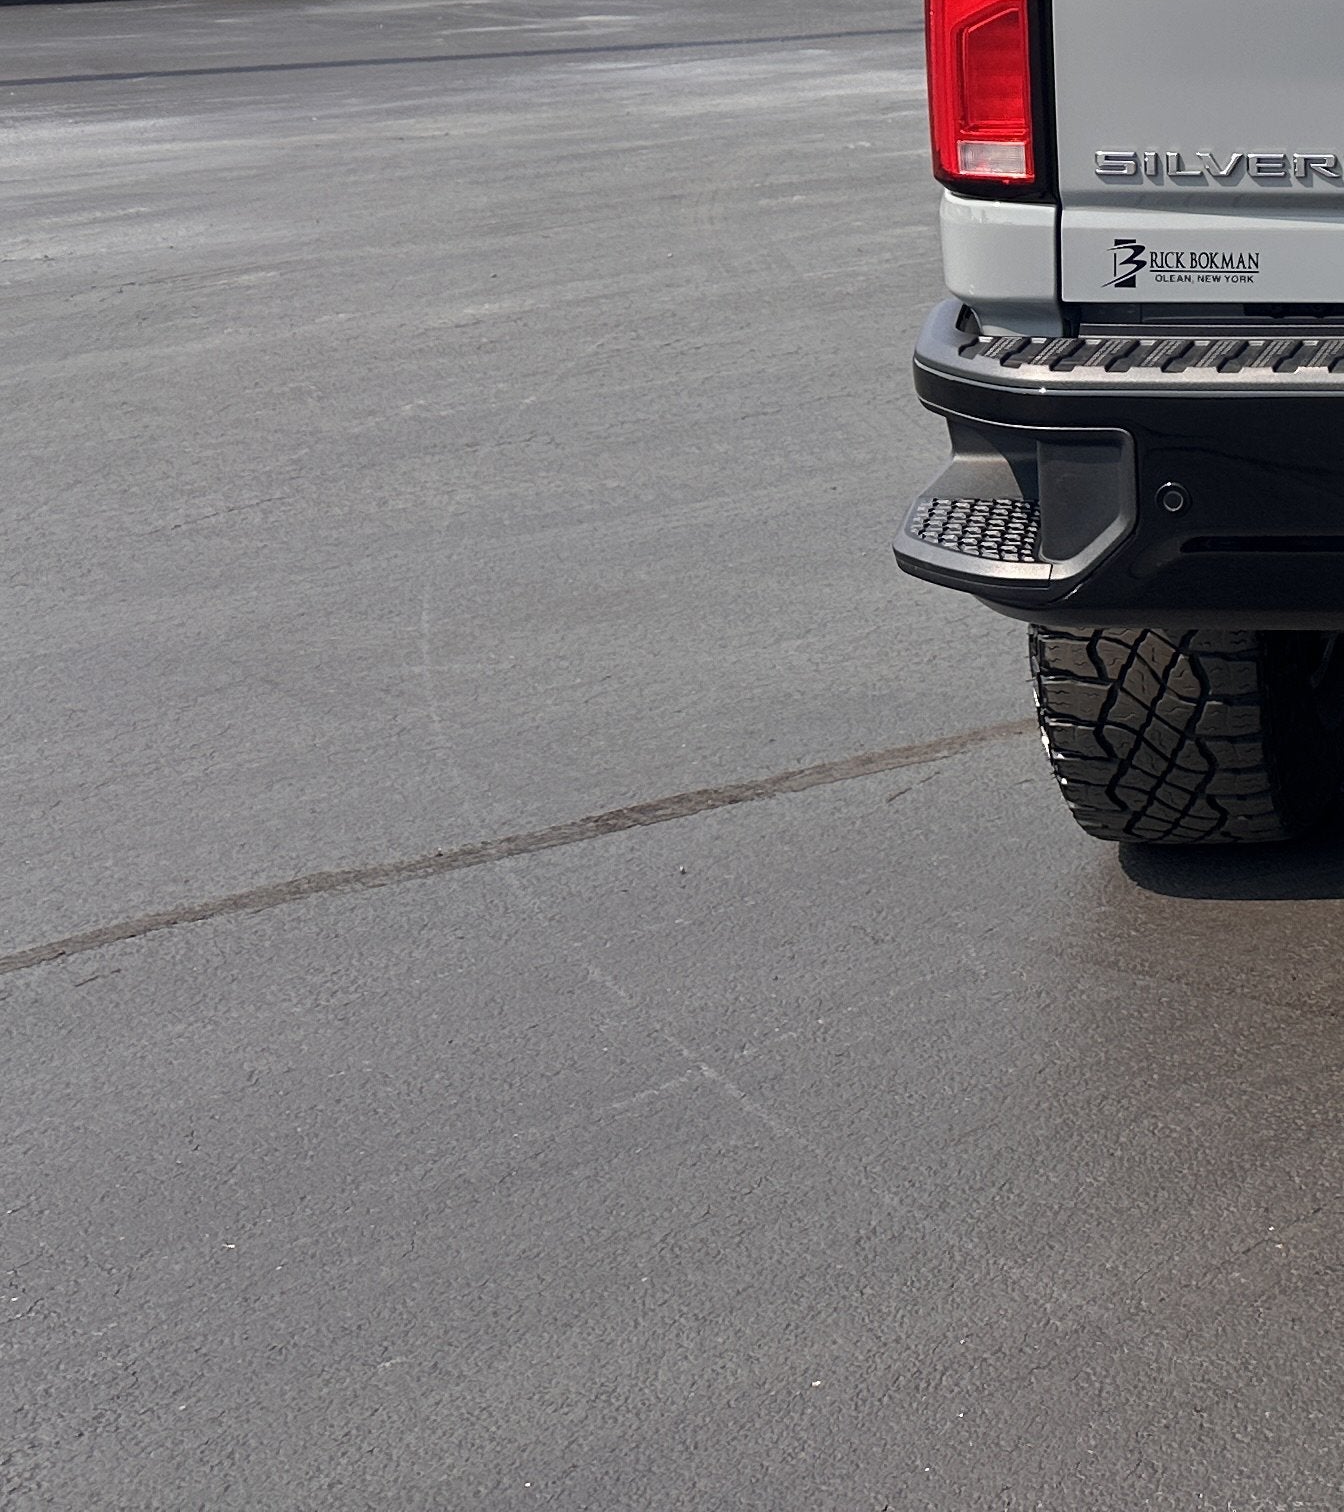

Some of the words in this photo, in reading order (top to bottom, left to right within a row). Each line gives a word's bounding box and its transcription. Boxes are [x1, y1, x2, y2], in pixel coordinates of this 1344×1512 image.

[1150, 251, 1184, 269] RICK
[1190, 252, 1259, 270] BOKMAN
[1155, 274, 1194, 284] OLEAN,
[1198, 275, 1221, 284] NEW
[1224, 275, 1254, 284] YORK
